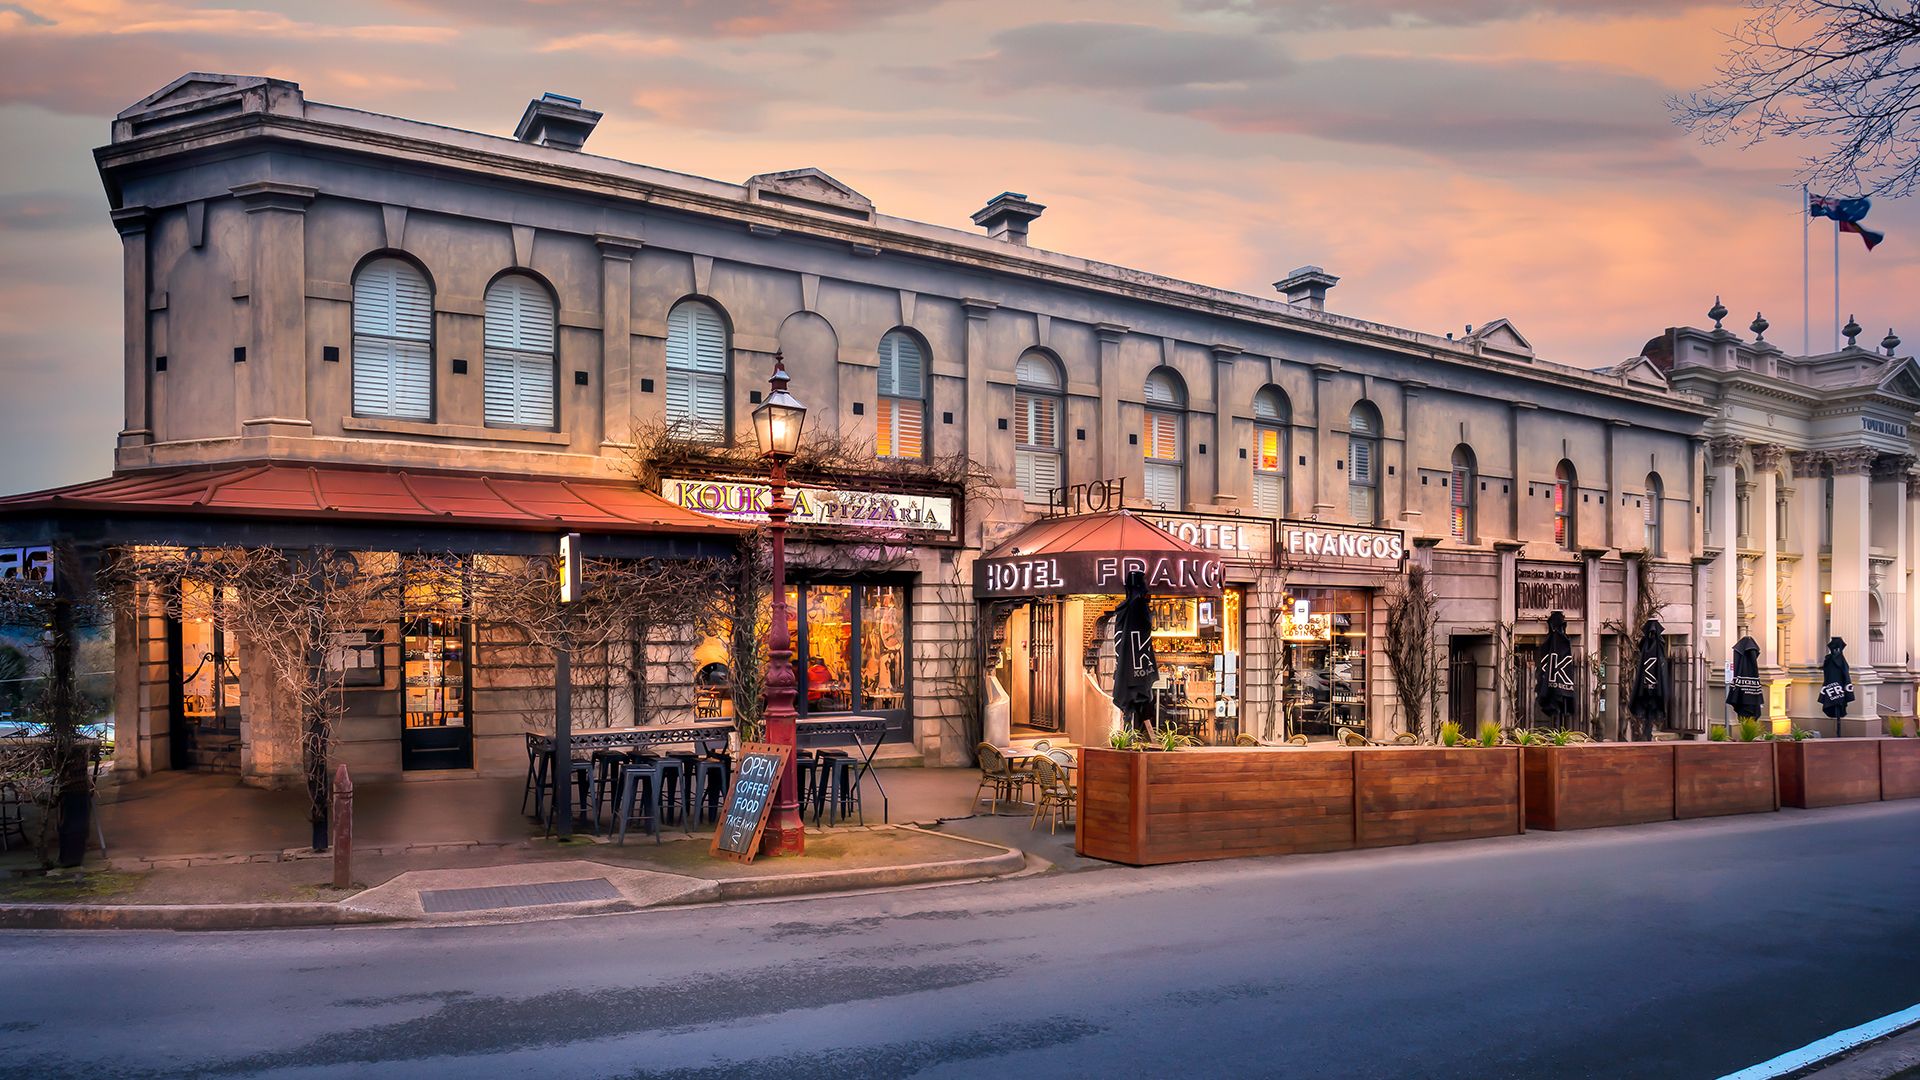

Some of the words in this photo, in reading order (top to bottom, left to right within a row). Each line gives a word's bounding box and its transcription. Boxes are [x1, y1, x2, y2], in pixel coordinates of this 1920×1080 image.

[1862, 417, 1884, 433] TOWN
[1885, 423, 1906, 438] HALL
[676, 482, 813, 517] KOUKA
[825, 502, 938, 523] PIZZARIA
[1288, 530, 1403, 560] FRANGOS
[987, 559, 1064, 590] HOTEL
[1548, 652, 1574, 685] K
[741, 756, 778, 779] OPEN
[736, 780, 768, 796] COFFEE
[734, 797, 760, 813] FOOD
